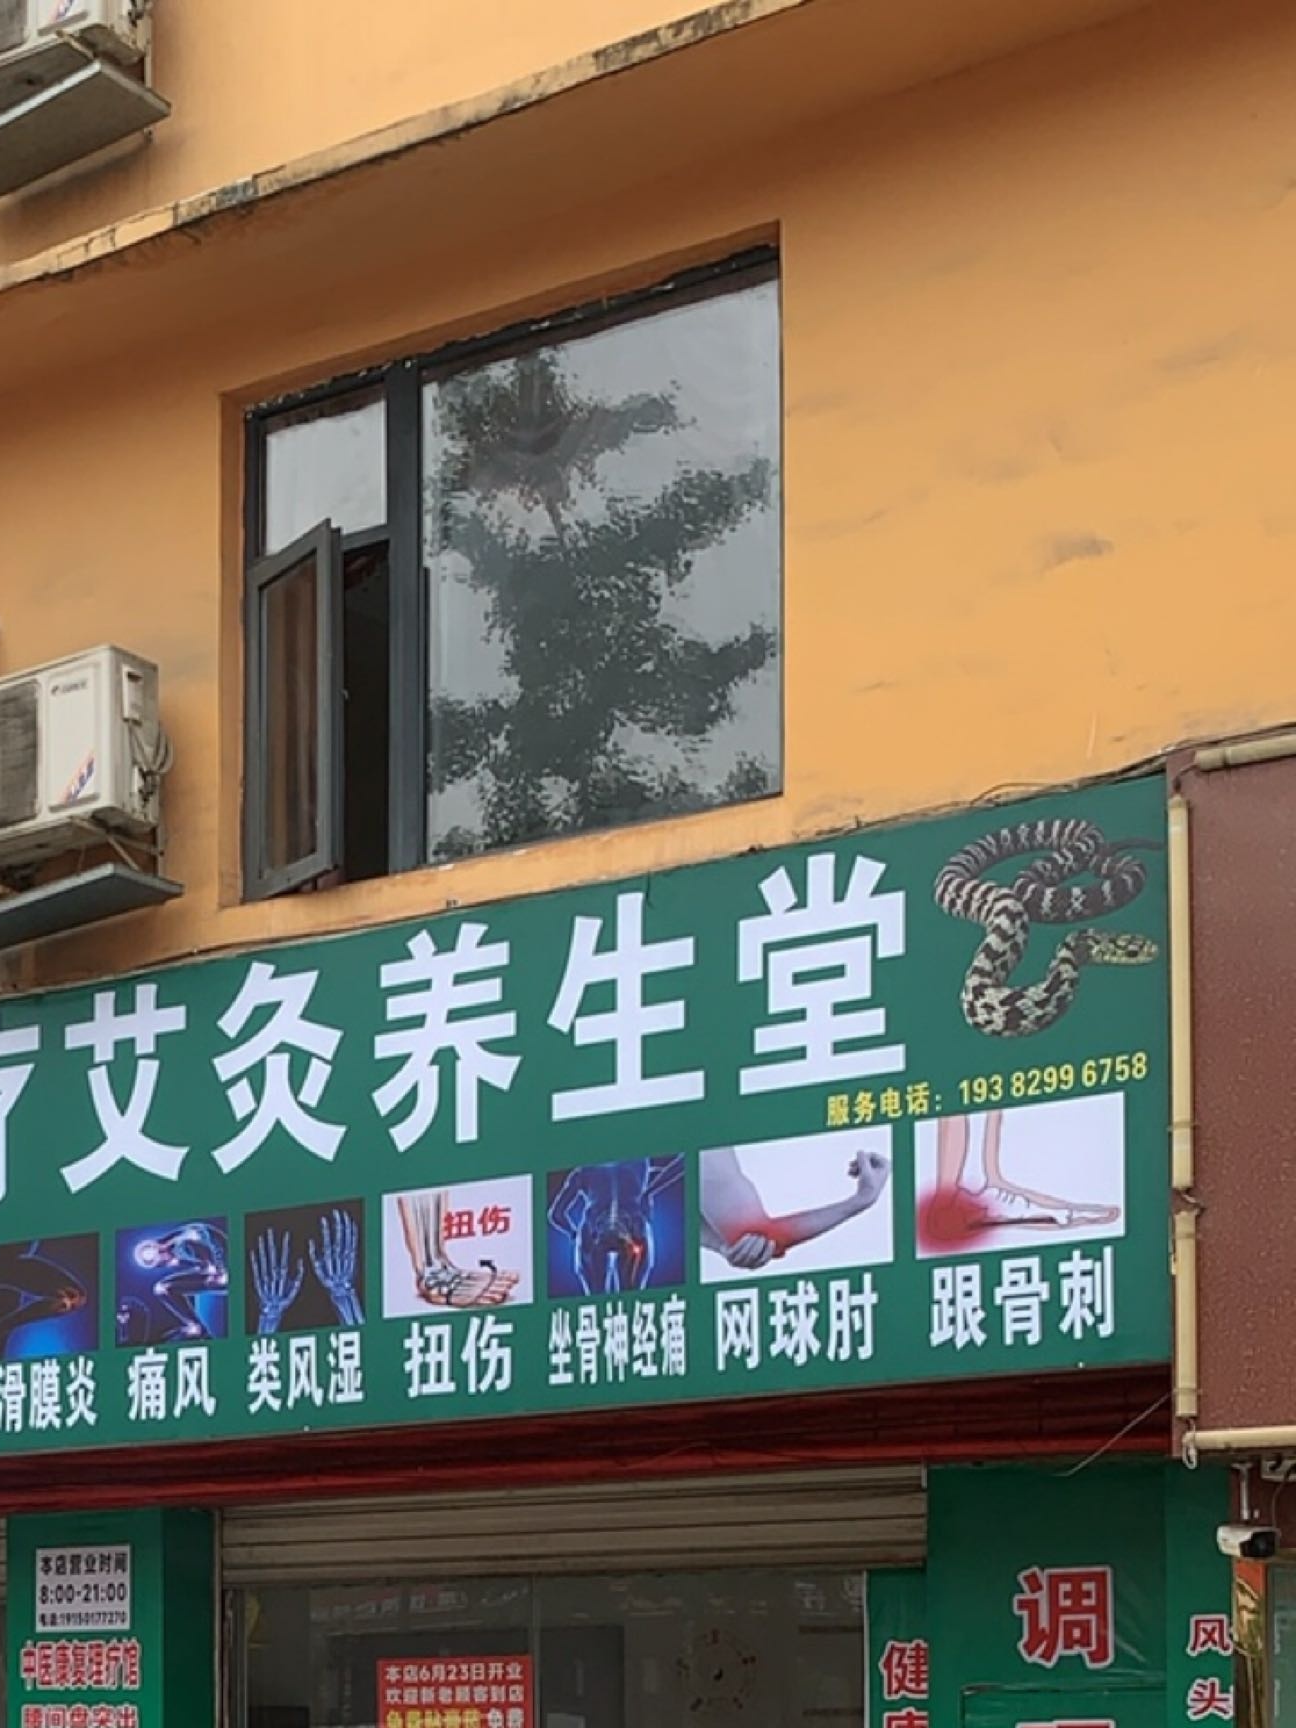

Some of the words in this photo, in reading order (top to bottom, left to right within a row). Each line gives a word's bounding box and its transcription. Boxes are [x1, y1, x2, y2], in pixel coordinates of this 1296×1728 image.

[958, 1074, 1004, 1105] 193
[1010, 1063, 1075, 1098] 8299
[1081, 1051, 1148, 1089] 6758
[442, 1202, 512, 1243] 扭伤
[715, 1271, 880, 1372] 网球肘
[929, 1245, 1117, 1351] 跟骨刺
[403, 1314, 514, 1398] 扭伤
[548, 1293, 688, 1386] 坐骨神经痛
[127, 1345, 217, 1421] 痛风
[247, 1331, 364, 1414] 类风湿
[40, 1552, 128, 1576] 本店营业时间
[40, 1582, 127, 1605] 8:00-21:00
[21, 1640, 140, 1690] 中医康复理疗馆
[385, 1662, 523, 1683] 本店6月23日开业
[385, 1684, 524, 1705] 欢迎新老顾客到店
